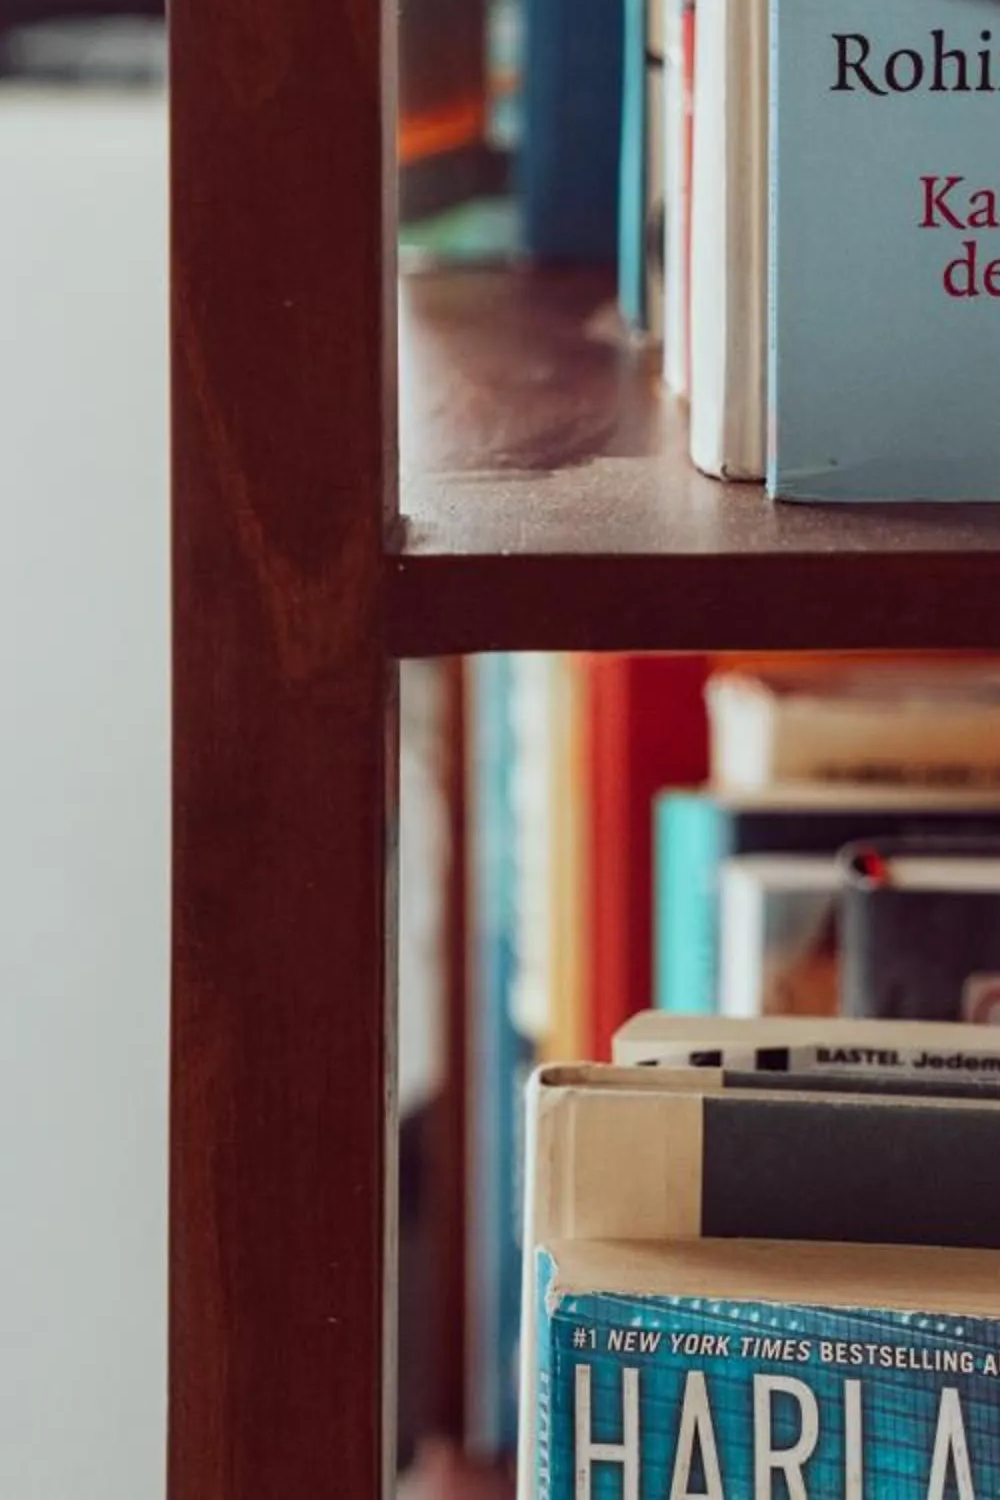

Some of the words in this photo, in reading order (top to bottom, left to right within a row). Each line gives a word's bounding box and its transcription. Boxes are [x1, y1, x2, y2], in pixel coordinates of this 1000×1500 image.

[573, 1327, 597, 1349] #1
[607, 1329, 661, 1352] NEW
[670, 1332, 731, 1357] YORK
[739, 1336, 812, 1362] TIMES
[820, 1341, 974, 1373] BESTSELLING
